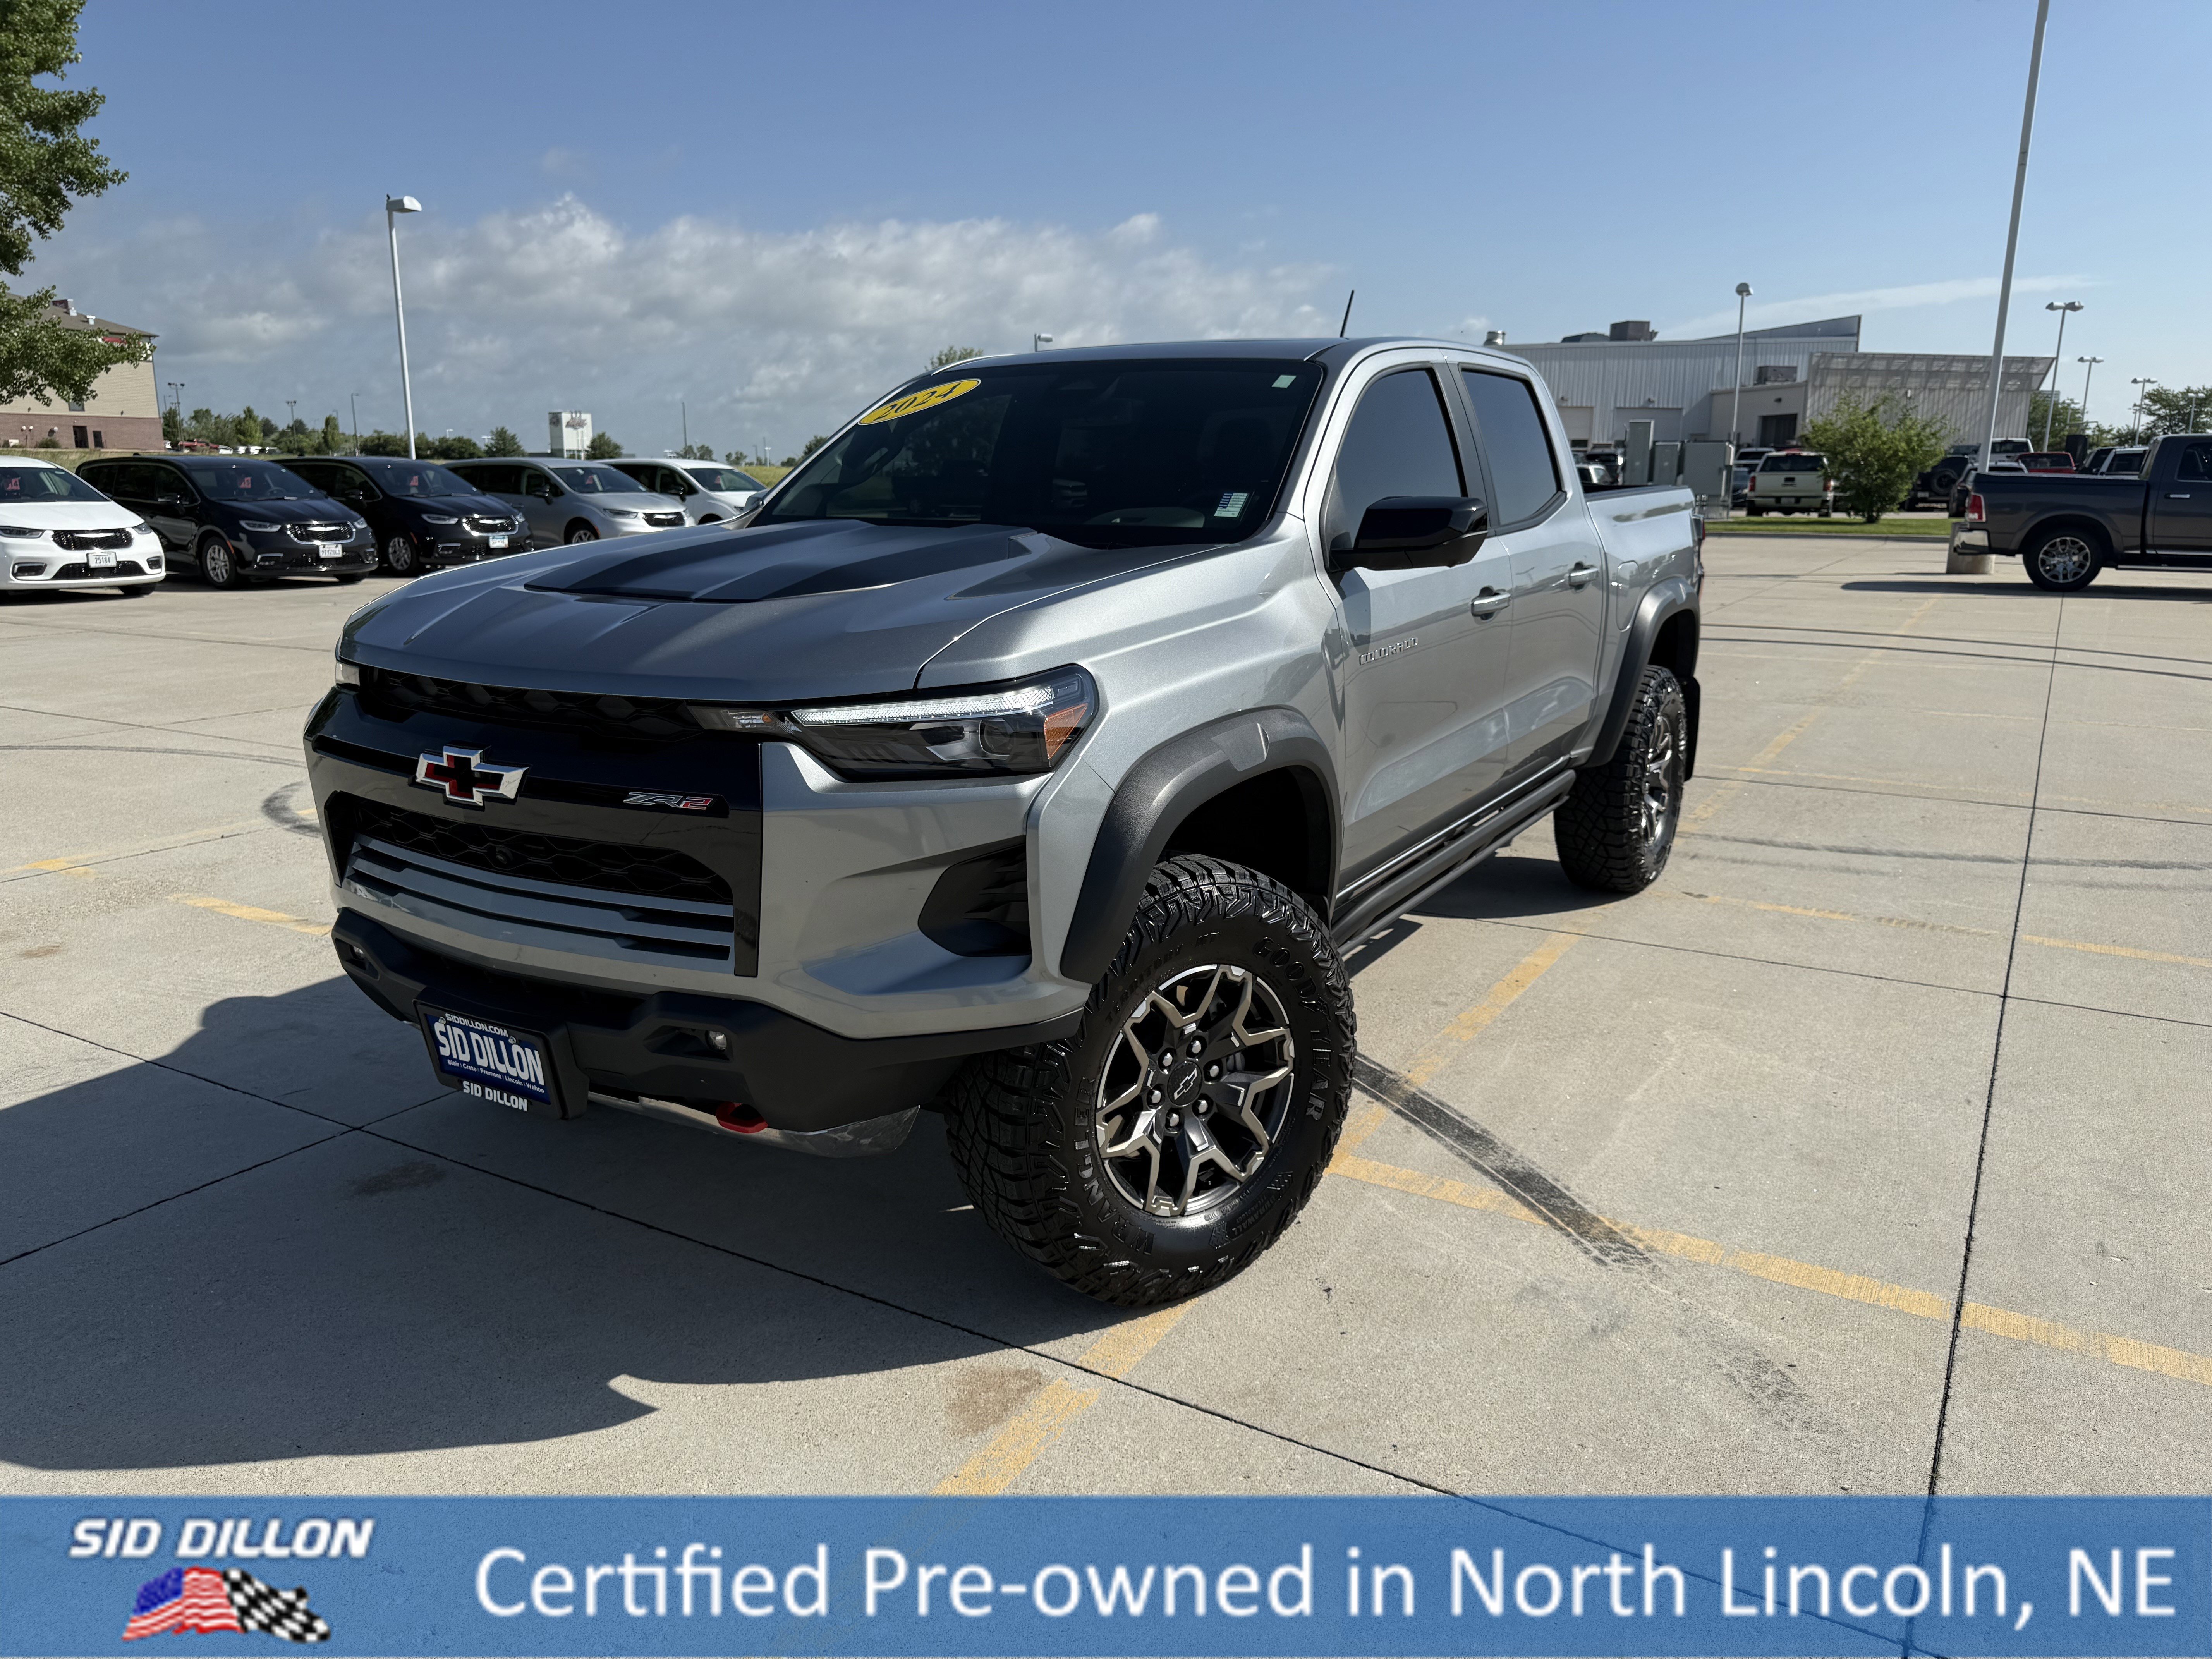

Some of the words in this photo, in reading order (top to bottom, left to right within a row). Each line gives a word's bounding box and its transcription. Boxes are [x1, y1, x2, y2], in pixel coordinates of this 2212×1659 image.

[872, 382, 962, 422] 2024
[1359, 637, 1419, 665] COLORADO
[623, 791, 714, 811] ZR2
[445, 1013, 508, 1037] SIDDILLON.COM
[1253, 936, 1331, 1121] GOODYEAR
[434, 1022, 470, 1063] SID
[469, 1031, 545, 1086] DILLON
[447, 1059, 460, 1068] Blair
[462, 1063, 477, 1073] Crete
[480, 1068, 502, 1080] Fremont
[505, 1075, 523, 1086] Lincoln
[526, 1082, 545, 1094] Wahoo
[463, 1080, 482, 1097] SID
[485, 1087, 528, 1112] DILLON
[1075, 1077, 1156, 1255] WRANGLER
[1232, 1196, 1278, 1236] DURAWALL
